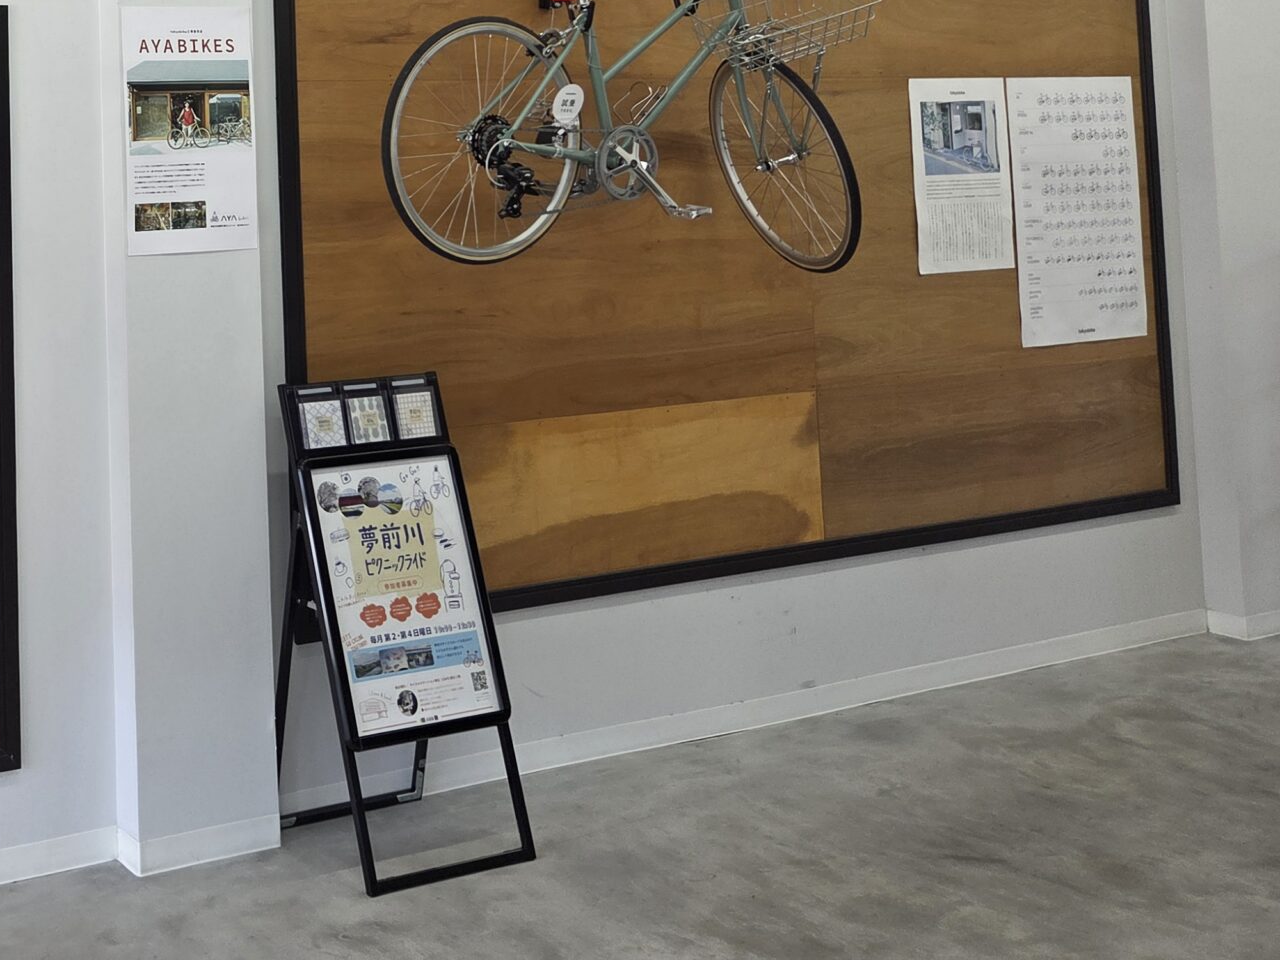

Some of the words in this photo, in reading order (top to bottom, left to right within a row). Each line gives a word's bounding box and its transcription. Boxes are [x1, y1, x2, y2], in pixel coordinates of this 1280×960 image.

[138, 38, 235, 54] AYABIKES
[358, 522, 425, 554] 夢前川
[364, 551, 427, 576] ピクニックライド
[369, 634, 383, 644] 毎月
